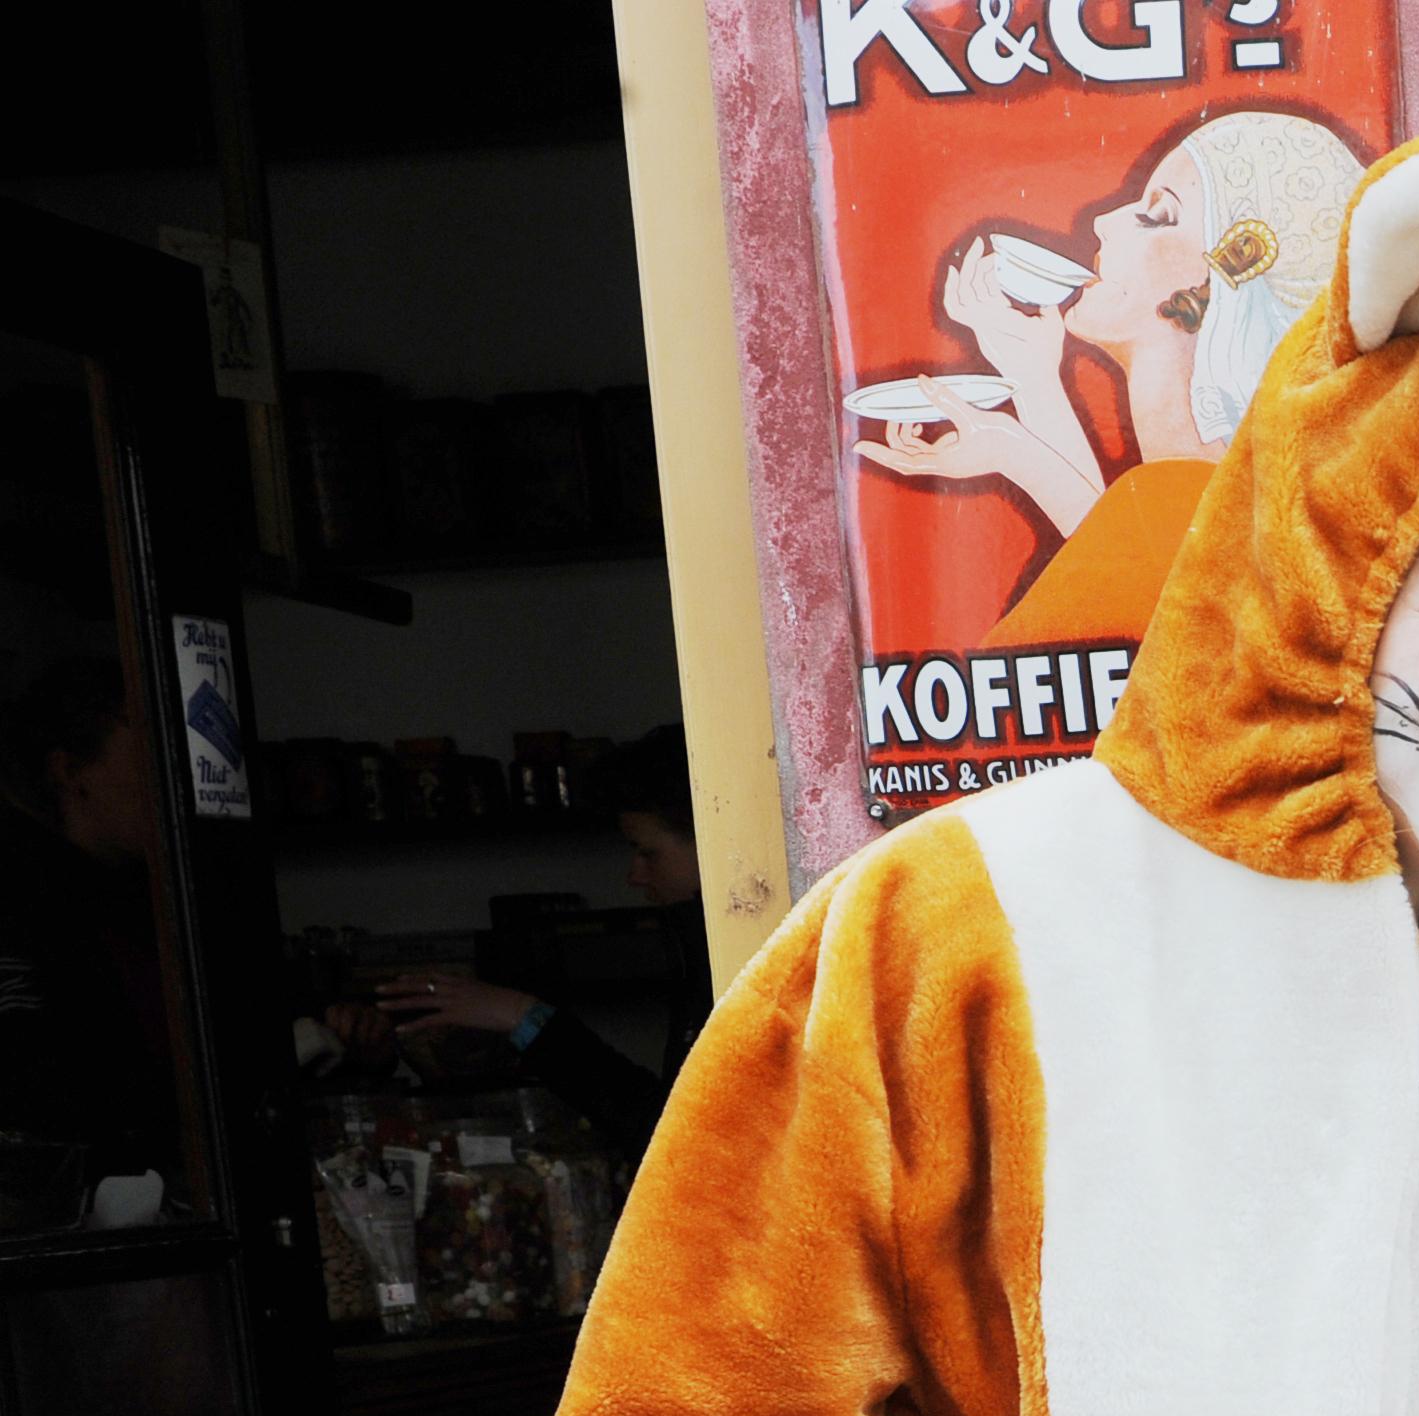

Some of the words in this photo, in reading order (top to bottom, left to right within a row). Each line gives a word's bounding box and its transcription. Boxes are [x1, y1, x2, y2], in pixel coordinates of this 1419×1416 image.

[862, 649, 1129, 745] KOFFIE
[868, 763, 950, 795] KANIS
[957, 761, 982, 791] &
